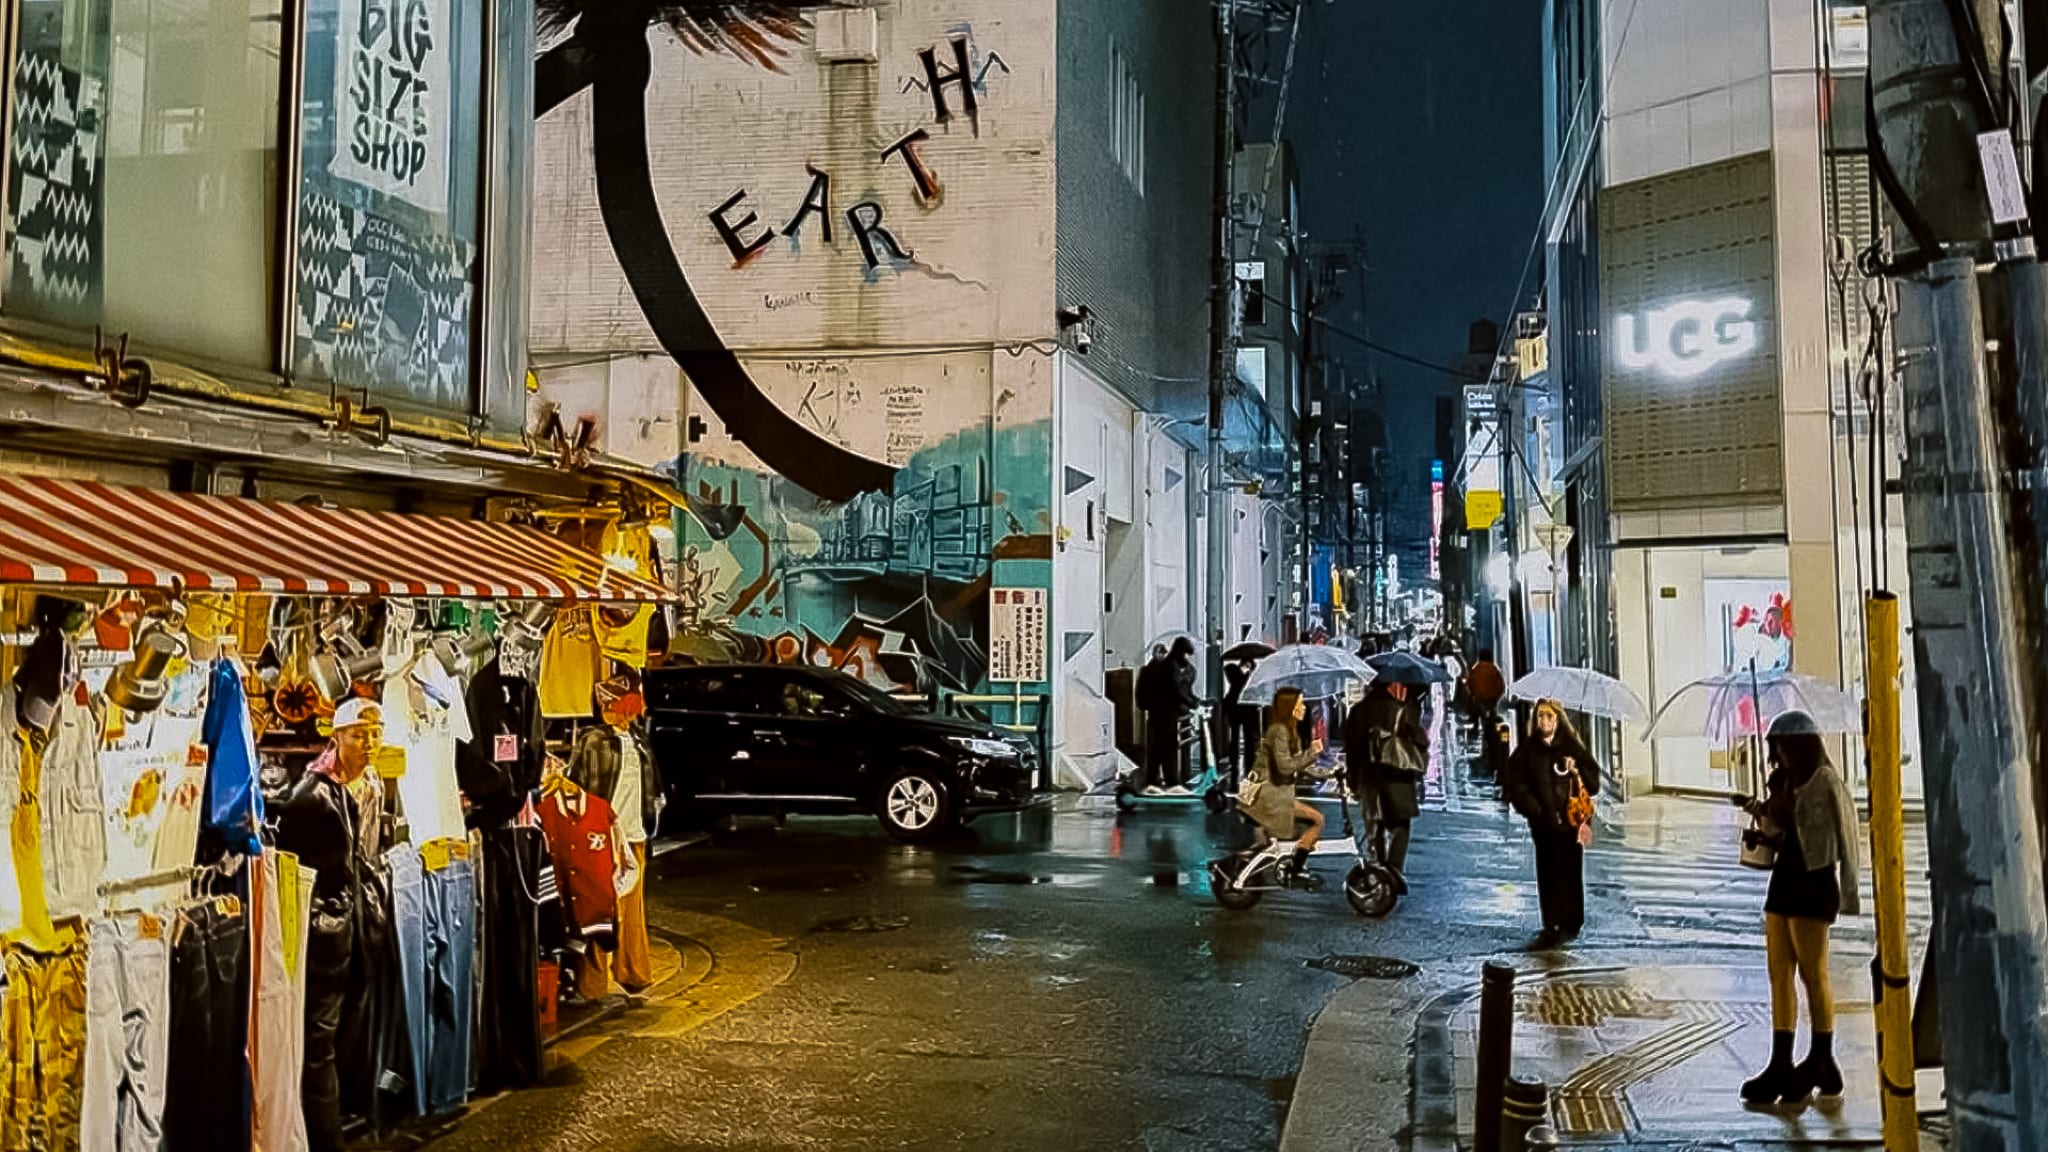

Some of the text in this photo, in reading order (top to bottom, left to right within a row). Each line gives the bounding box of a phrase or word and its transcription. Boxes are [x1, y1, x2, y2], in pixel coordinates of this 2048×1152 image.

[350, 50, 428, 137] SIZE
[351, 114, 426, 187] SHOP
[708, 36, 980, 272] EARTH
[1614, 297, 1756, 377] UGG
